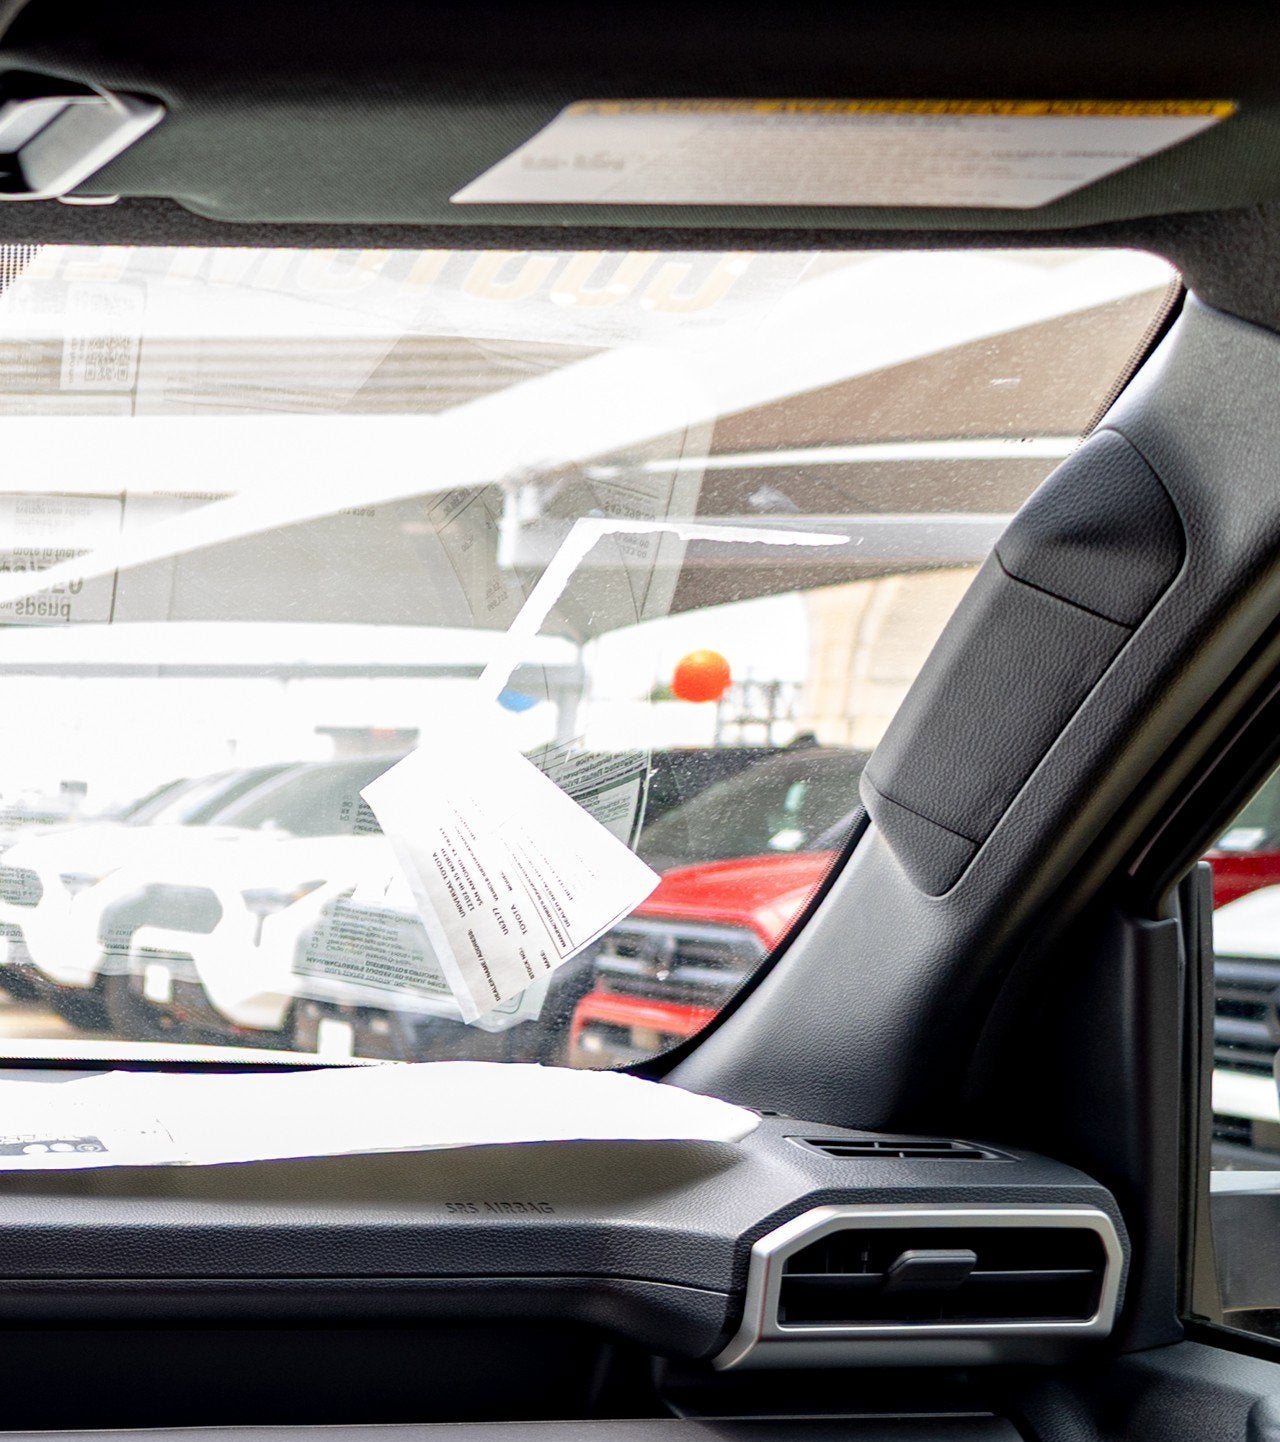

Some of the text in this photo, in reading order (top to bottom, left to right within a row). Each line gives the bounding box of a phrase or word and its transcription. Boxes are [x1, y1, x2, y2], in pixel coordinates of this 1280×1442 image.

[445, 882, 467, 918] UNIVERSAL
[510, 904, 528, 935] TOYOTA
[488, 976, 502, 1002] DEALER
[445, 1202, 555, 1214] SRS AIRBAG
